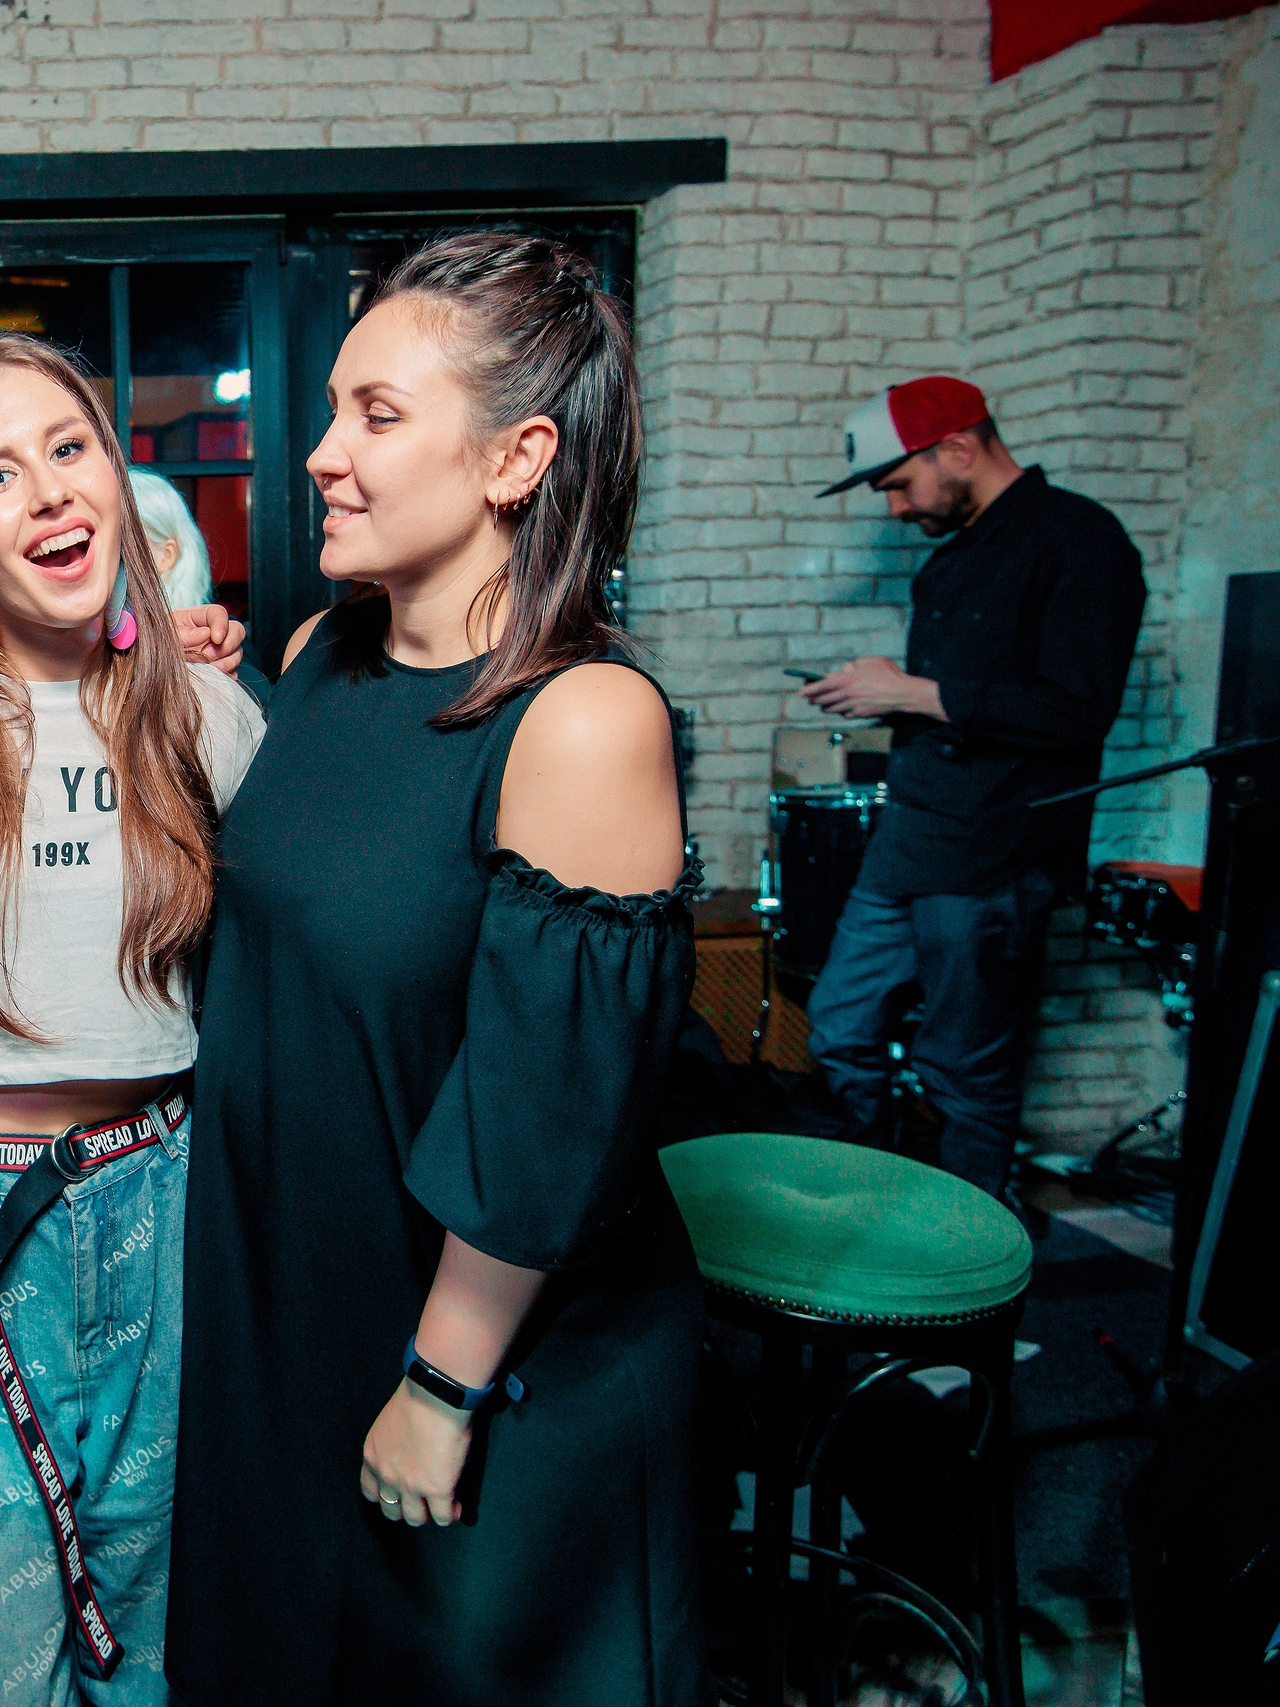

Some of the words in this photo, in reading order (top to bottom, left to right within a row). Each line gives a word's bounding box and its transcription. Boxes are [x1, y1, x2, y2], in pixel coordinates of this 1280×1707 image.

[32, 842, 90, 867] 199X
[0, 1143, 44, 1165] TODAY
[84, 1125, 133, 1158] SPREAD
[124, 1469, 148, 1487] NOW
[6, 1376, 31, 1425] TODAY
[32, 1442, 61, 1501] SPREAD
[55, 1498, 74, 1541] LOVE
[66, 1535, 83, 1584] TODAY
[82, 1601, 113, 1659] SPREAD
